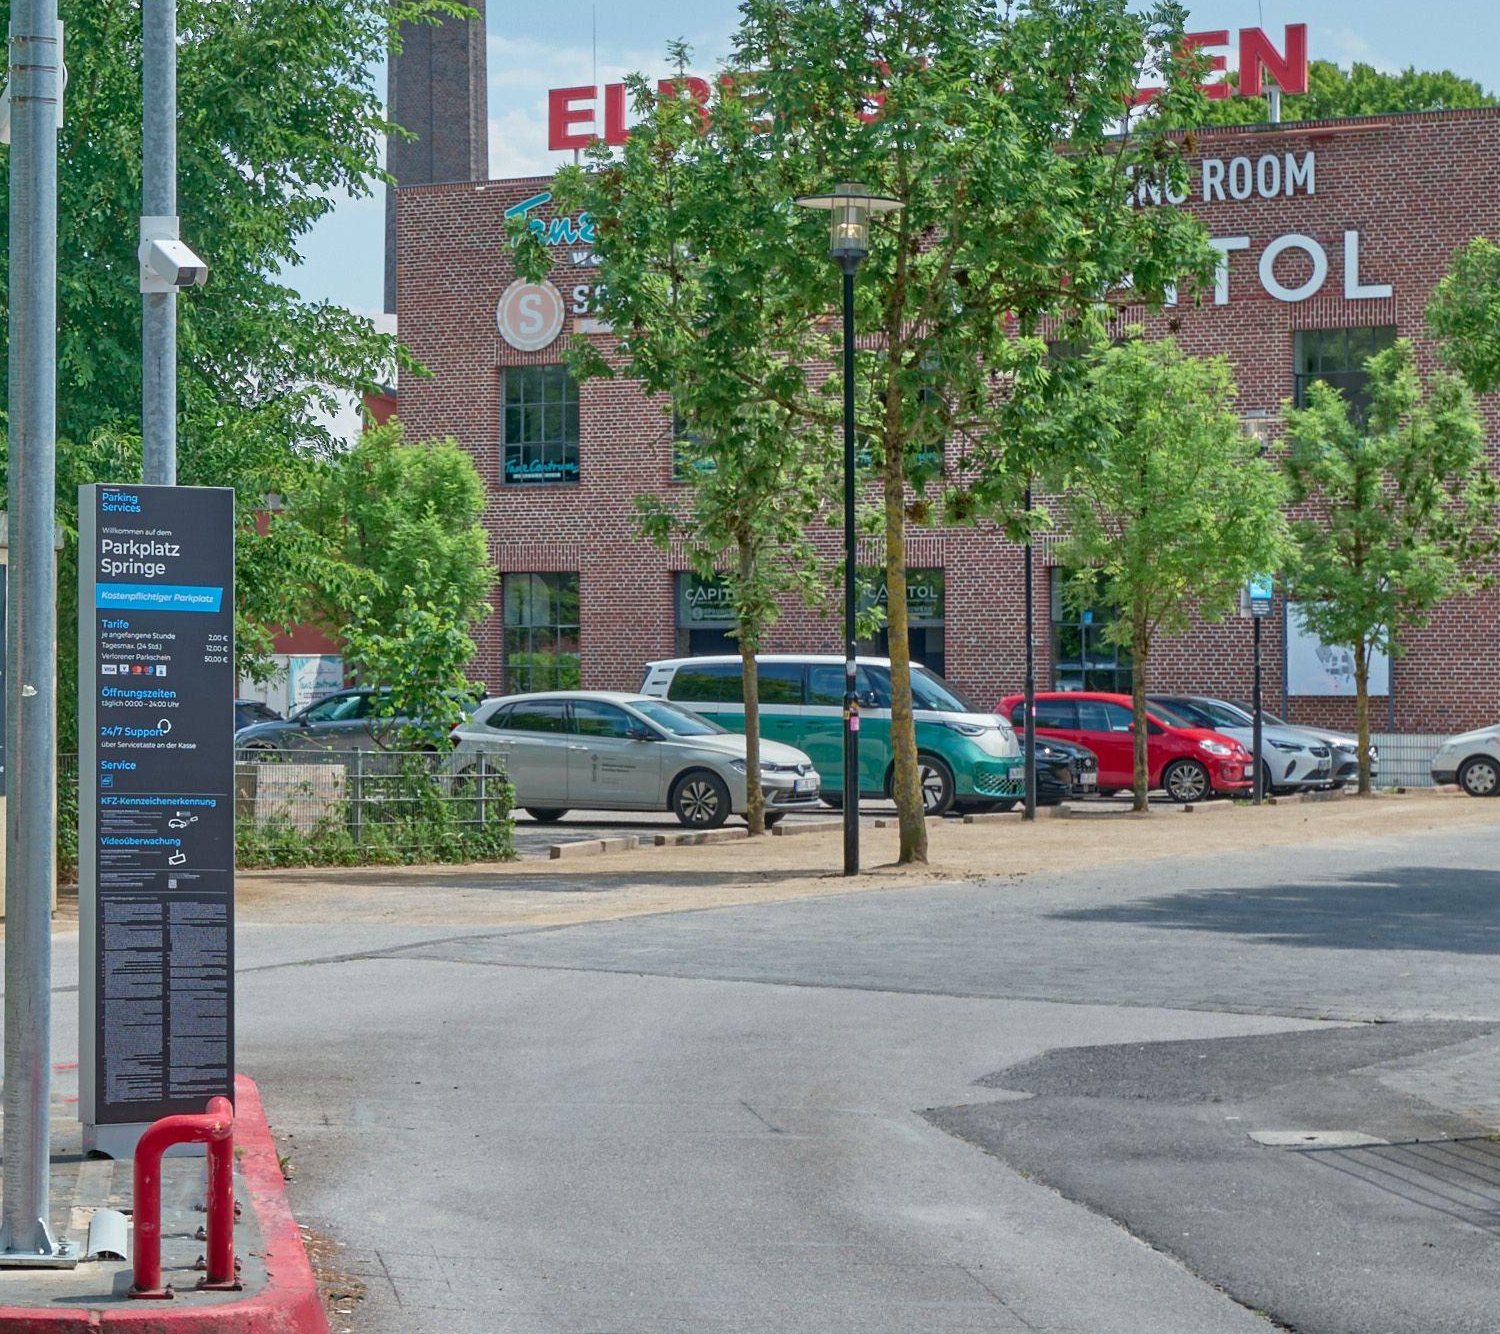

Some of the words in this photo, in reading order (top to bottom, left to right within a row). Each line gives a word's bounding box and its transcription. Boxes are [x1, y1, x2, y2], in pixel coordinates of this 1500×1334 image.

[1203, 151, 1315, 202] ROOM
[519, 293, 544, 333] S
[102, 492, 138, 504] Parking
[102, 503, 141, 513] Services
[101, 538, 180, 559] Parkplatz
[100, 558, 166, 578] Springe
[102, 592, 172, 603] Kostenpflichtiger
[174, 593, 214, 604] Parkplatz
[867, 583, 938, 605] CATOL
[102, 618, 130, 629] Tarife
[109, 632, 152, 640] angefangene
[136, 642, 147, 651] (24
[102, 653, 136, 661] Verlorener
[136, 654, 172, 662] Parkschein
[102, 686, 176, 700] Öffnungszeiten
[101, 727, 122, 736] 24/7
[124, 726, 164, 738] Support
[100, 760, 136, 770] Service
[100, 796, 216, 808] KFZ-Kennzeichenerkennung
[100, 837, 181, 847] Videoüberwachung
